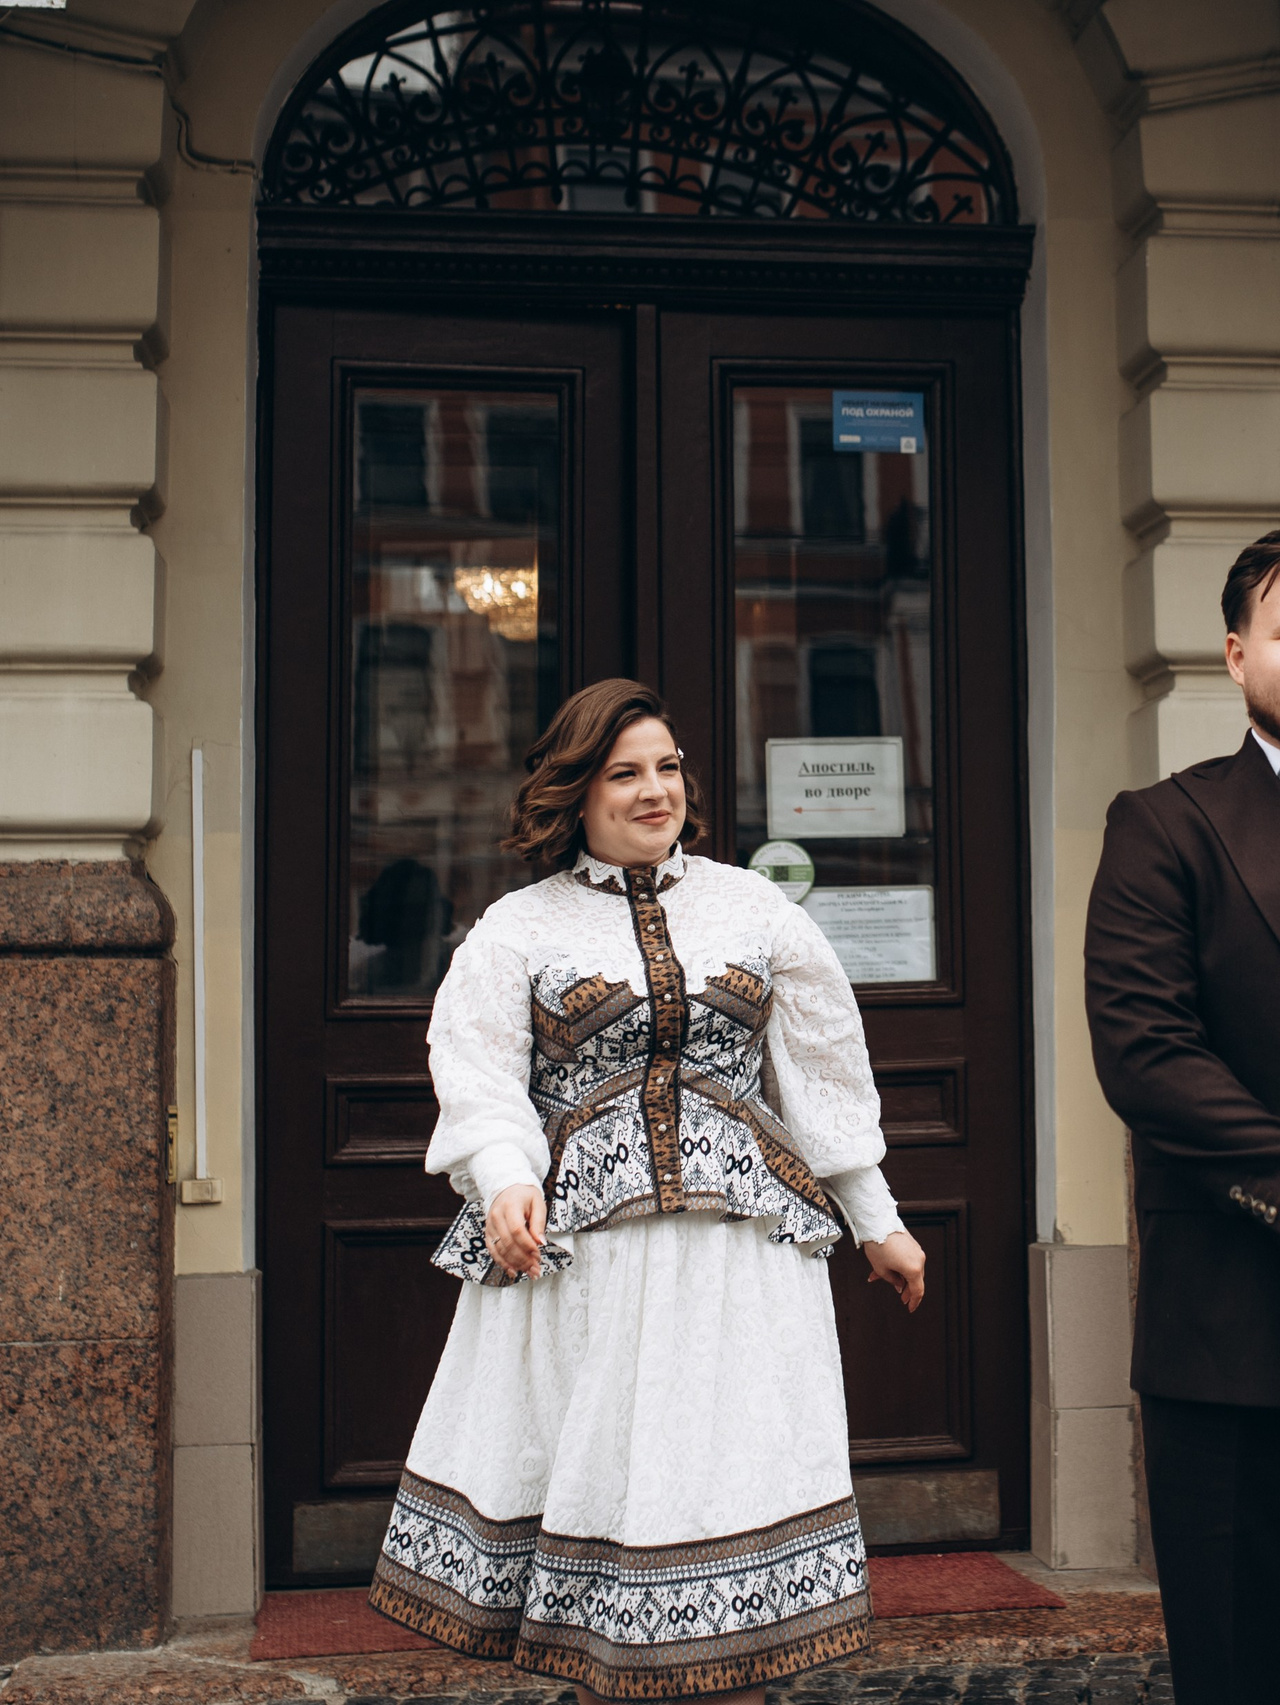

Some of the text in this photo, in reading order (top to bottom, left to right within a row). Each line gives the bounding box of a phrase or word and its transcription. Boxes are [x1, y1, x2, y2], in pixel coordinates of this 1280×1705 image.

[841, 407, 914, 418] ПОД ОХРАНОЙ
[799, 761, 875, 775] Апостиль
[804, 786, 871, 800] во дворе
